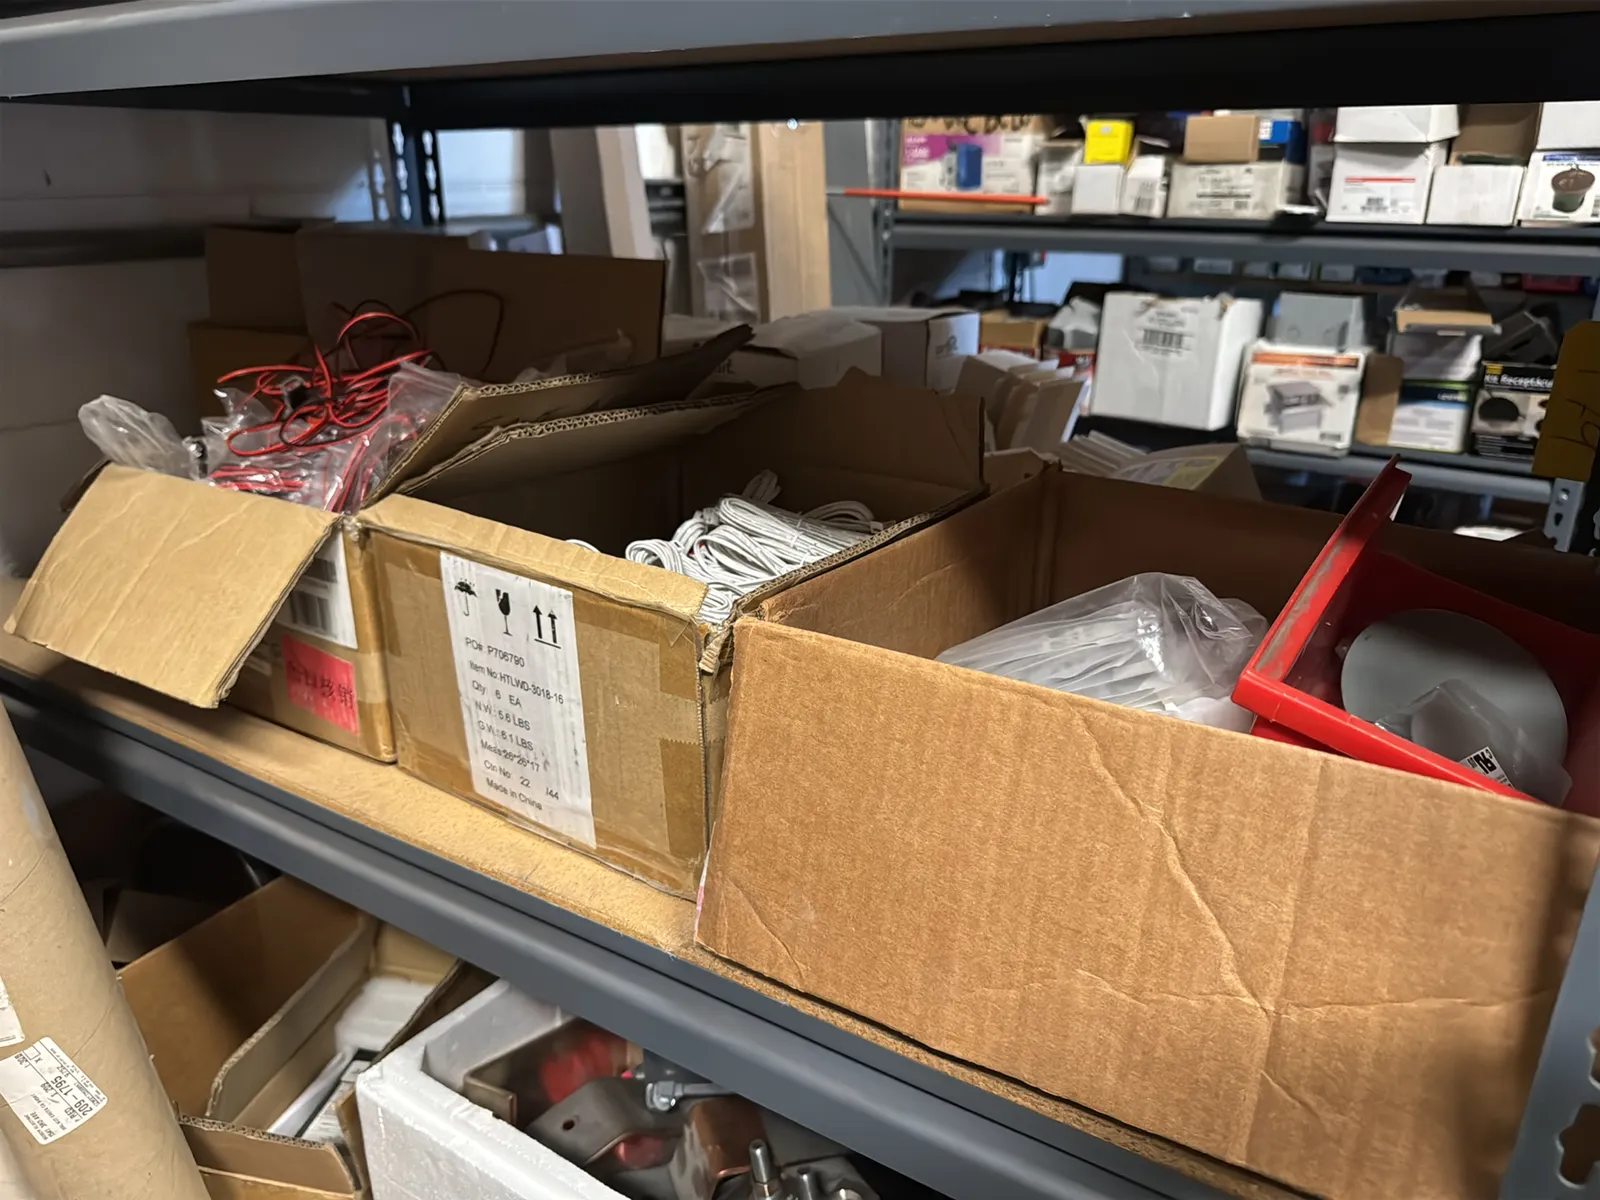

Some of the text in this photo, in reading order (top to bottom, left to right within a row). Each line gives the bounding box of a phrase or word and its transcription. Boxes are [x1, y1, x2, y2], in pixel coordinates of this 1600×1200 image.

[469, 660, 486, 675] Item
[495, 689, 502, 700] 6
[508, 694, 522, 708] EA
[513, 715, 531, 731] LBS
[515, 735, 534, 751] LBS
[519, 776, 531, 788] 22
[486, 777, 543, 811] Made in China
